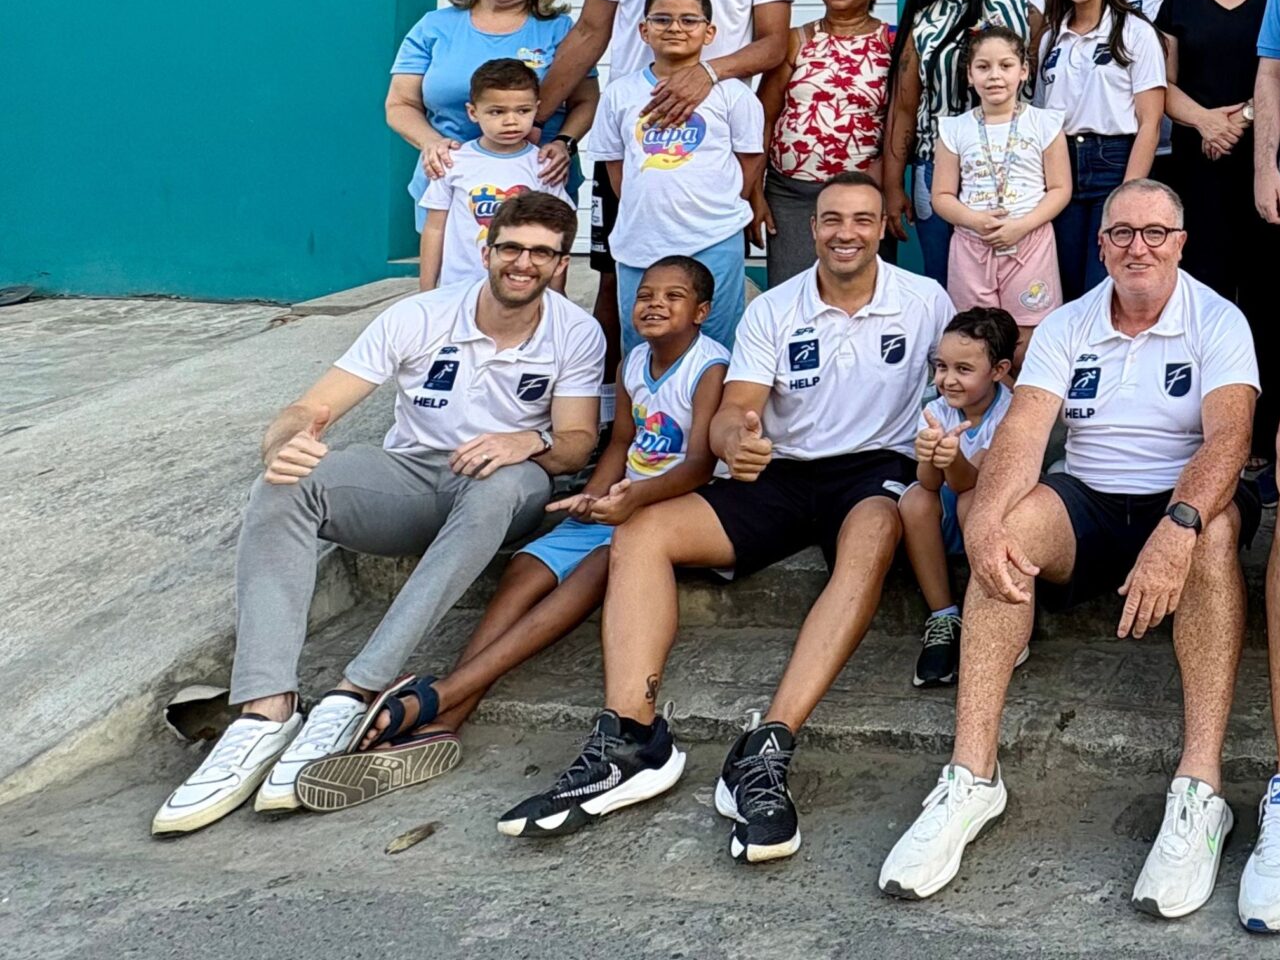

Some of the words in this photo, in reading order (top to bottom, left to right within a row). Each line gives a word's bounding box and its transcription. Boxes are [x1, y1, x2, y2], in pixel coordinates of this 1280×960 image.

[644, 127, 698, 148] acpa
[789, 376, 821, 390] HELP
[413, 395, 448, 409] HELP
[1065, 408, 1095, 419] HELP
